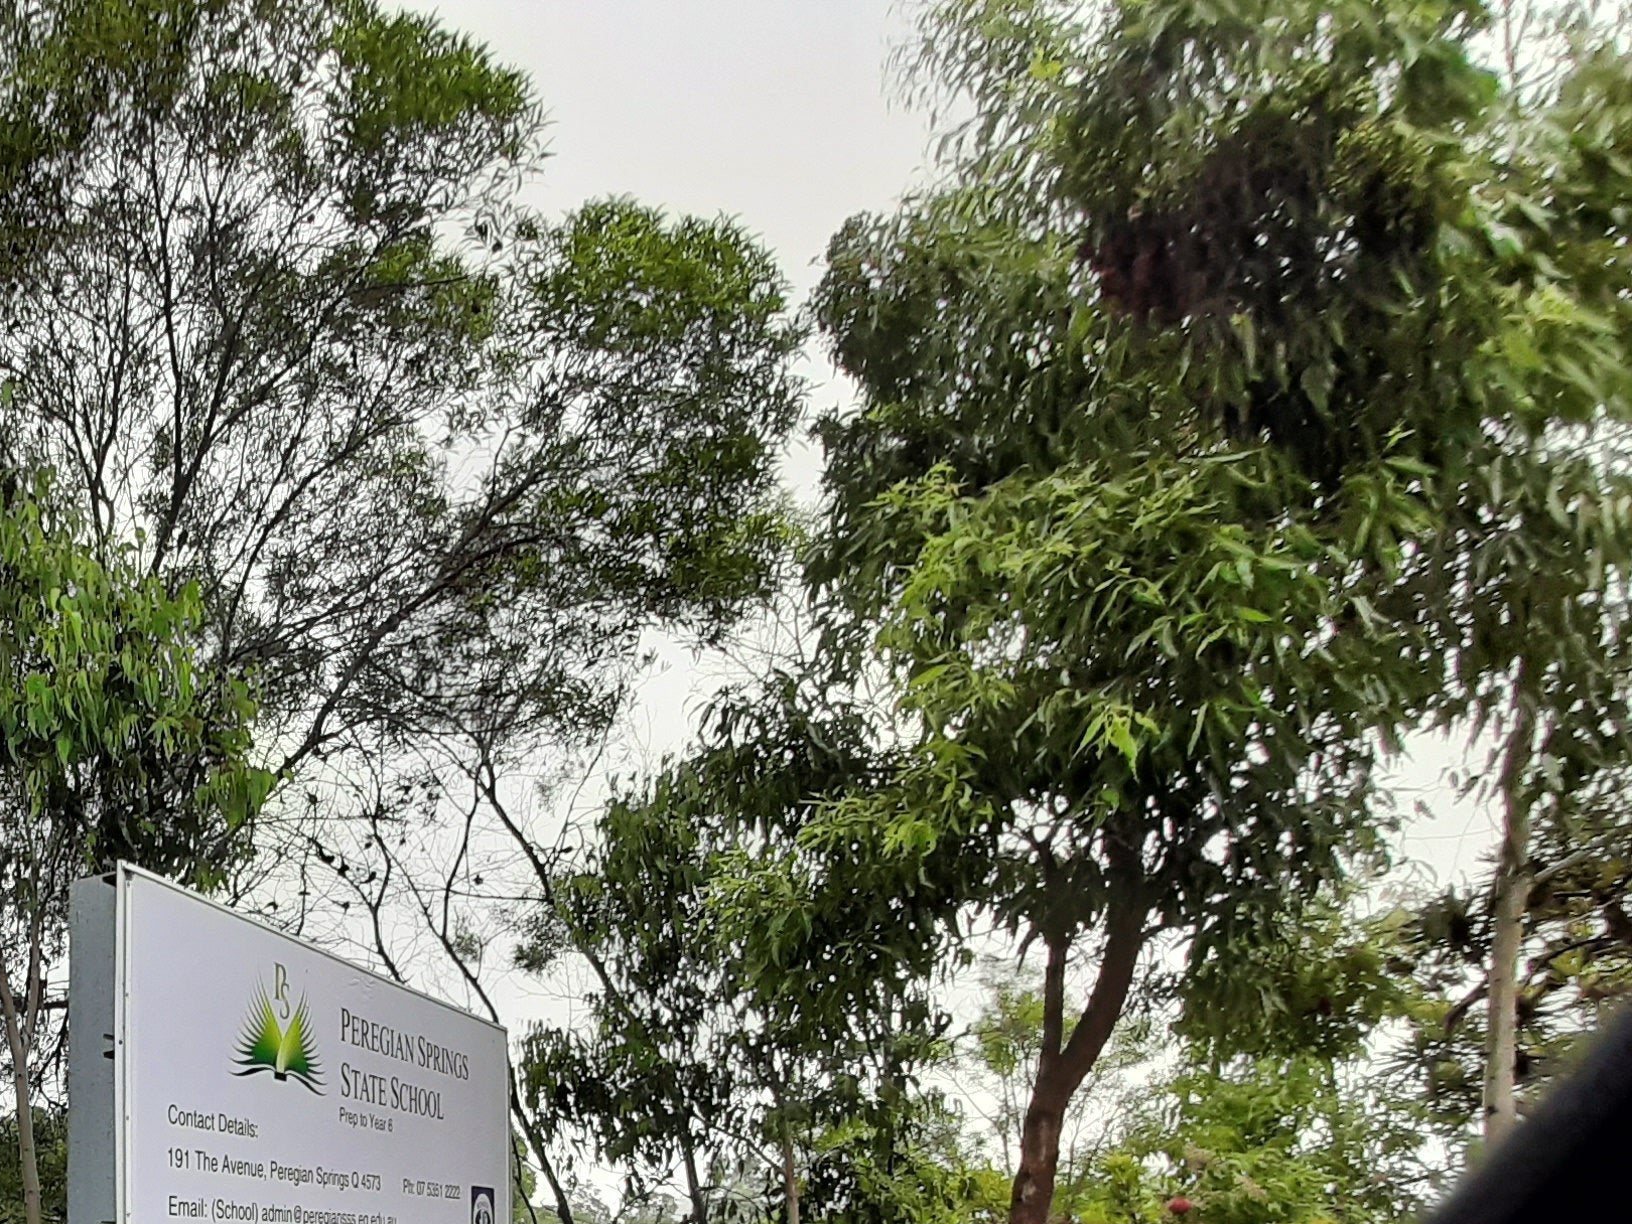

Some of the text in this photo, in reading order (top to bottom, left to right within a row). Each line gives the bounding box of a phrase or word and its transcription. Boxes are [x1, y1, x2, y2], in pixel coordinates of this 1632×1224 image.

[340, 1007, 469, 1081] PEREGIAN SPRINGS
[341, 1062, 444, 1120] STATE SCHOOL
[168, 1104, 258, 1138] Contact Details:
[339, 1107, 358, 1128] Prep
[360, 1111, 368, 1127] to
[368, 1113, 387, 1131] Year
[168, 1147, 381, 1192] 191 The Avenue, Peregian Springs Q 4573
[169, 1195, 207, 1218] Email:
[211, 1198, 258, 1224] (School)
